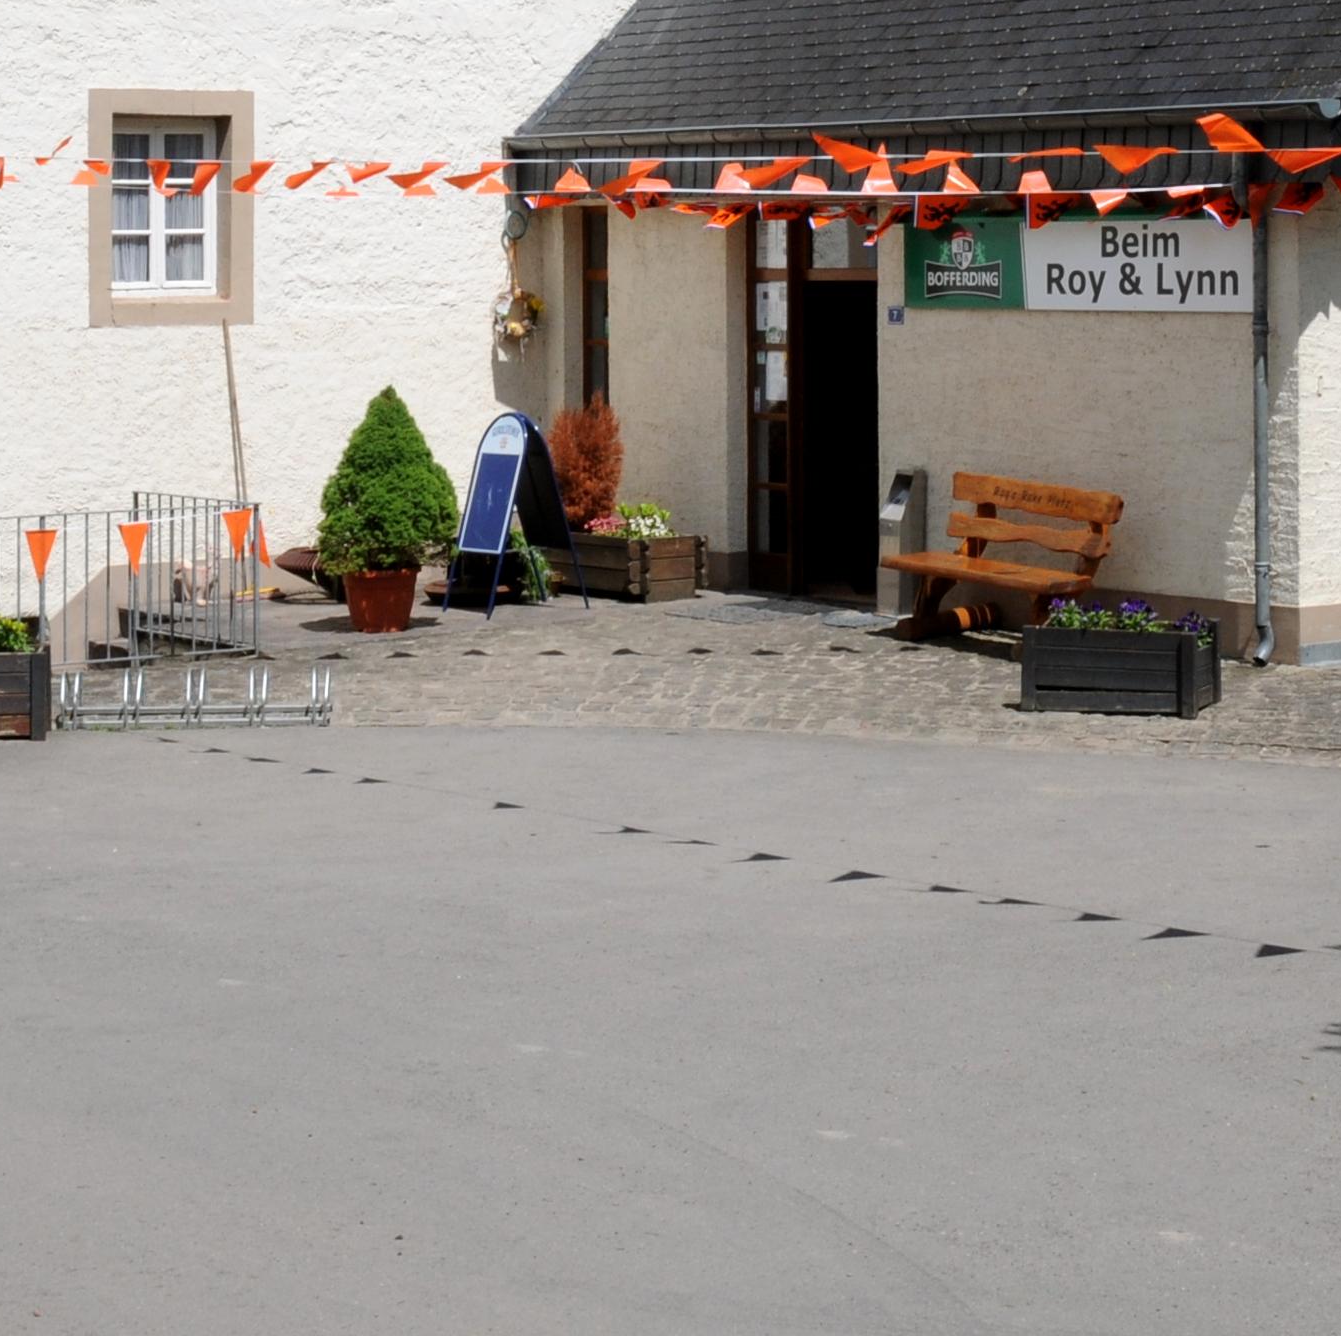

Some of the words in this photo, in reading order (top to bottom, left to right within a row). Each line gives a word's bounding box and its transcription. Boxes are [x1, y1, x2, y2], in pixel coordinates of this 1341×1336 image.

[1101, 224, 1180, 258] Beim
[927, 271, 999, 287] BOFFERDING
[1046, 263, 1106, 303] Roy
[1118, 262, 1144, 296] &
[1156, 263, 1239, 304] Lynn
